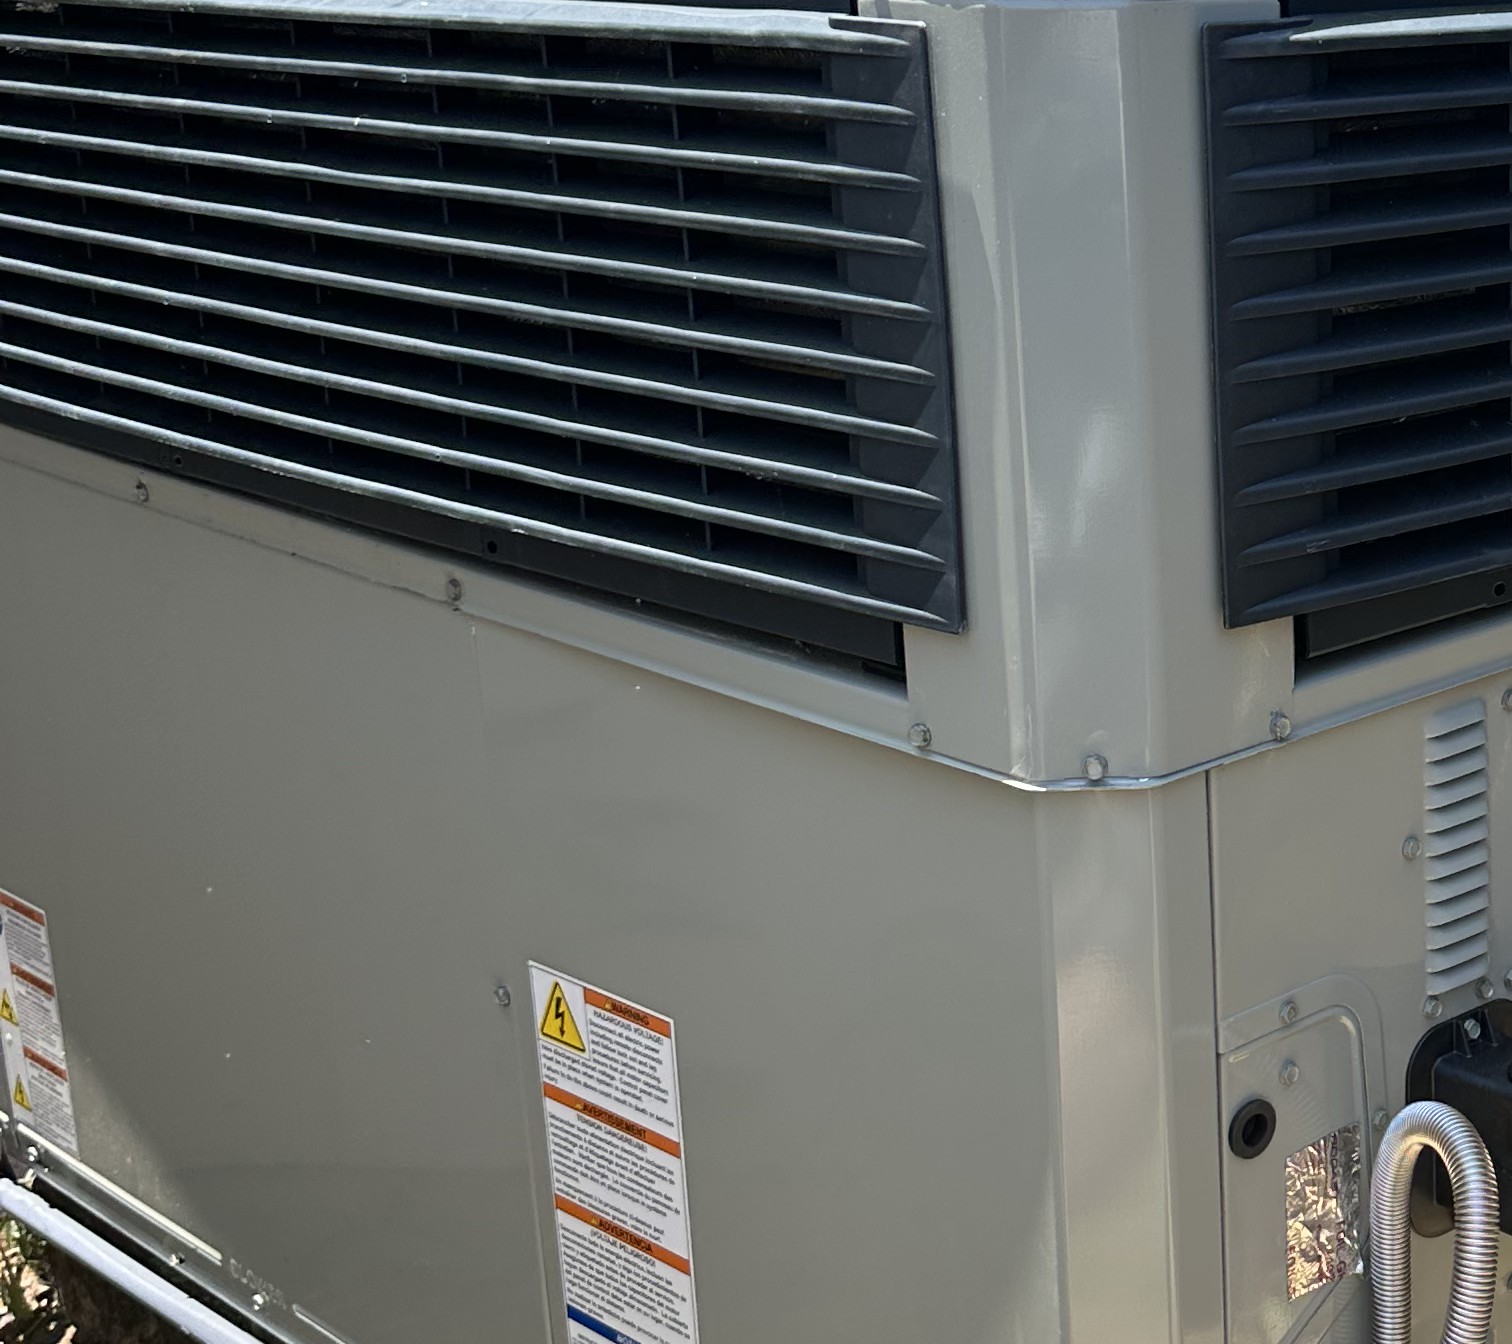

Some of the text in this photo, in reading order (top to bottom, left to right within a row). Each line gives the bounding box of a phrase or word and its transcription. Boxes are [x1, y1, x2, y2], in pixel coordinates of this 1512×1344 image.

[611, 1001, 649, 1026] WARNING
[581, 1101, 646, 1140] AVERTISSEMENT
[598, 1216, 652, 1254] ADVERTENCIA
